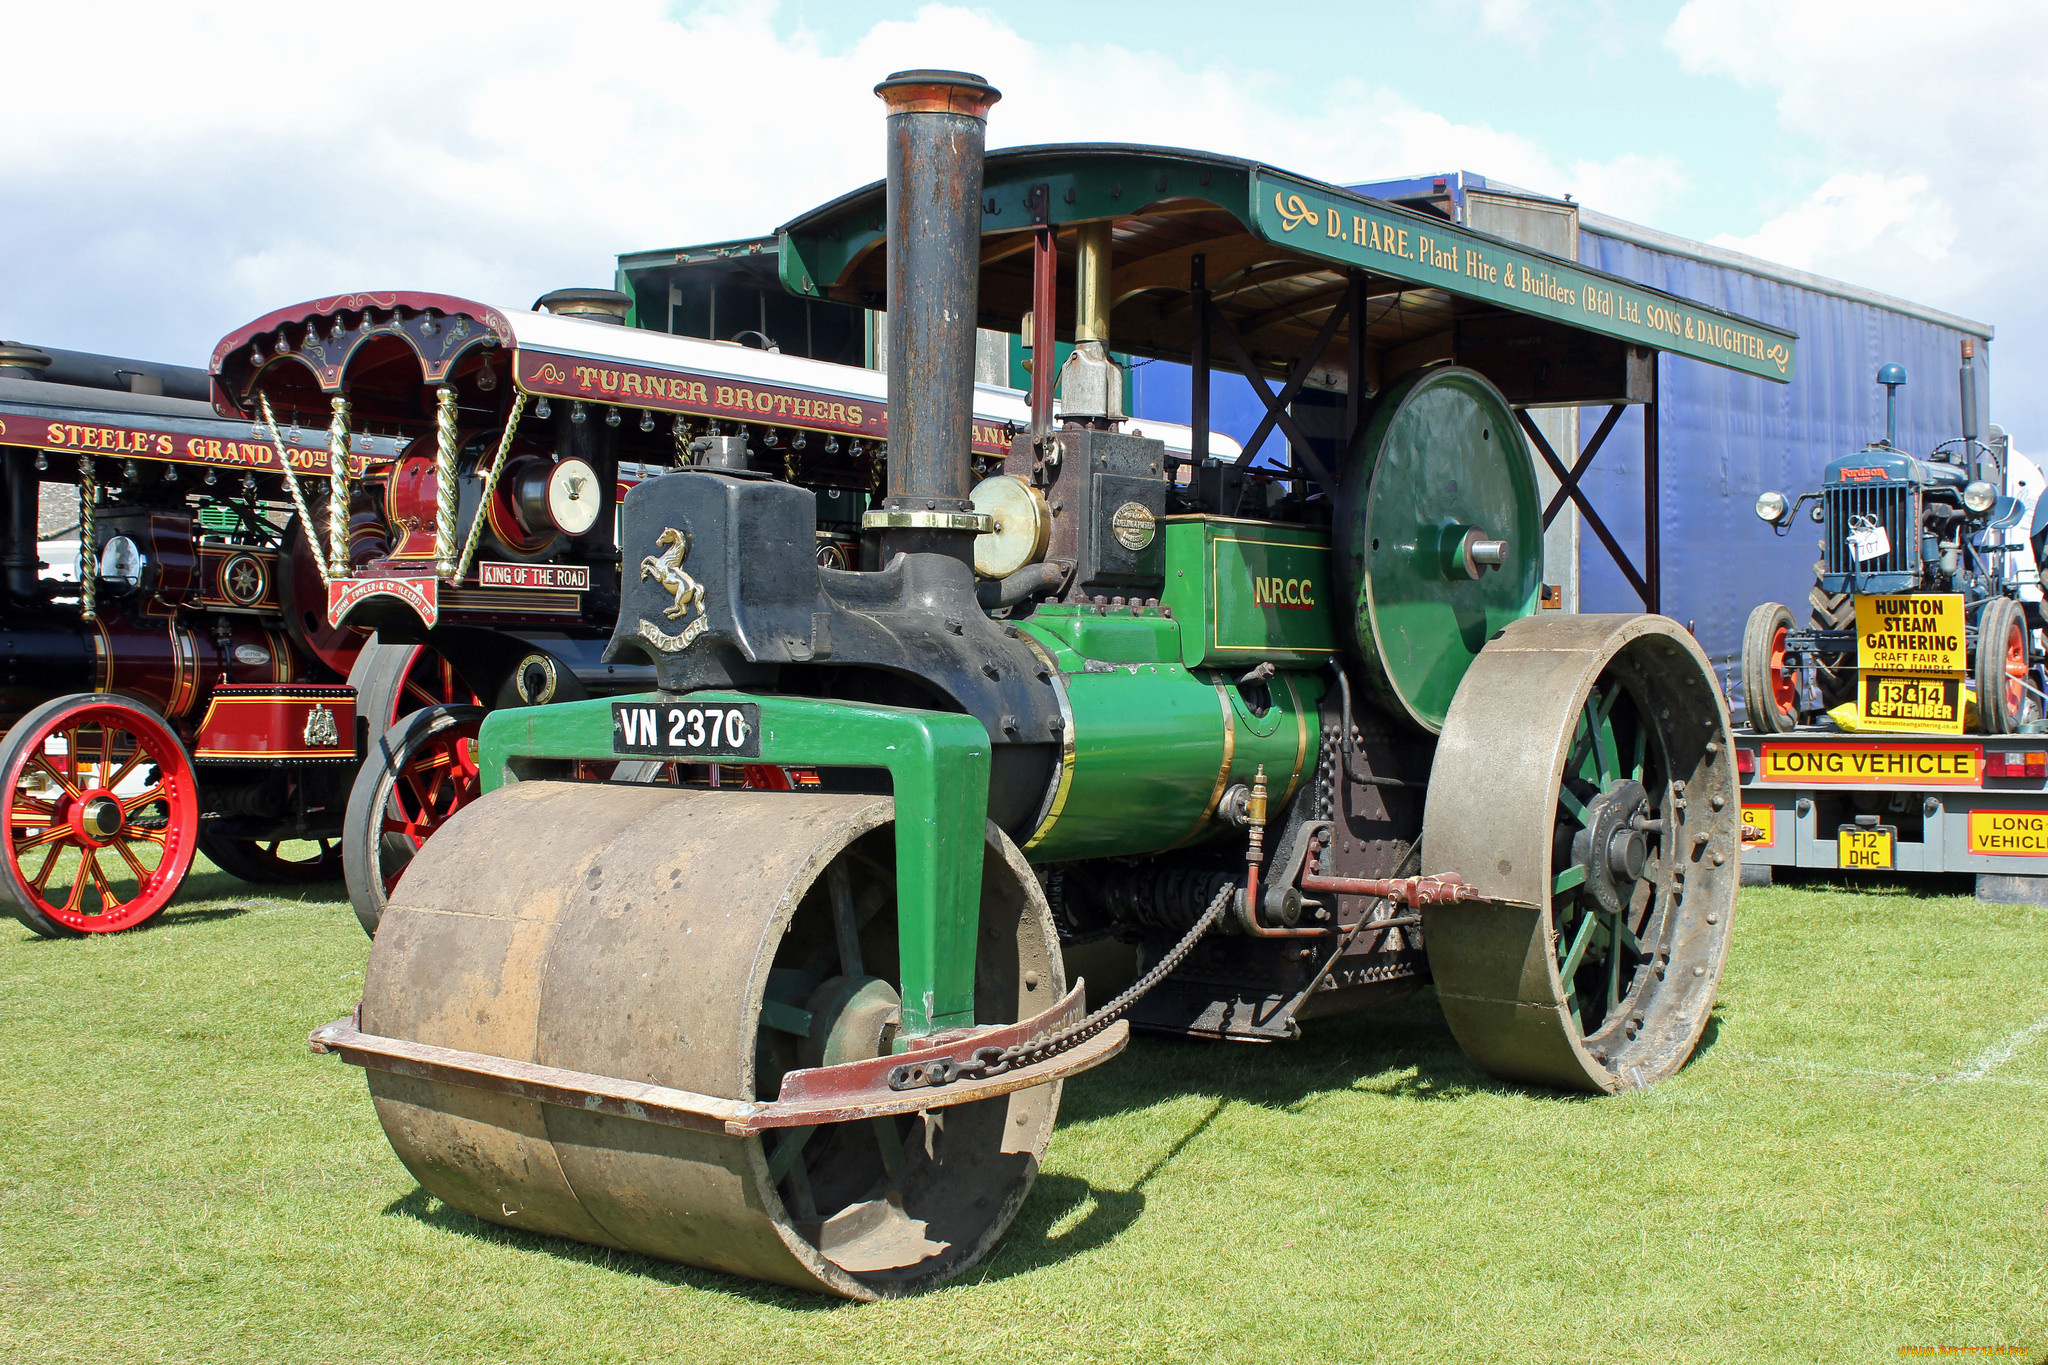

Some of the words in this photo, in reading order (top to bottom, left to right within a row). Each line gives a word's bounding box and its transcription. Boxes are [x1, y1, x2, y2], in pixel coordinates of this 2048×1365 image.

[1419, 235, 1459, 273] Plant
[1465, 250, 1498, 283] Hire
[1503, 262, 1516, 289] &
[1521, 266, 1576, 306] Builders
[1582, 283, 1614, 322] (Bfd)
[1618, 296, 1642, 325] Ltd.
[1646, 304, 1681, 335] SONS
[1684, 316, 1695, 340] &
[1697, 320, 1765, 361] DAUGHTER
[574, 365, 708, 403] TURNER
[715, 385, 864, 427] BROTHERS
[47, 422, 174, 456] STEELE'S
[187, 437, 273, 465] GRAND
[1840, 467, 1890, 482] Fordson
[484, 566, 512, 584] KING
[514, 568, 529, 584] OF
[532, 568, 554, 586] THE
[557, 569, 586, 587] ROAD
[335, 598, 350, 618] JOHN
[351, 583, 376, 600] FOWLER
[379, 582, 385, 590] &
[398, 585, 422, 607] (LEEDS)
[1875, 599, 1944, 616] HUNTON
[1884, 616, 1938, 633] STEAM
[1866, 633, 1958, 652] GATHERING
[1873, 651, 1909, 662] CRAFT
[1912, 653, 1938, 663] FAIR
[1942, 654, 1950, 664] &
[1872, 662, 1905, 673] AUTO
[1909, 664, 1954, 675] JUMBLE
[1882, 685, 1903, 703] 13
[1906, 687, 1917, 702] &
[1920, 687, 1941, 704] 14
[1870, 701, 1953, 719] SEPTEMBER
[620, 708, 658, 746] VN
[668, 708, 746, 748] 2370
[1772, 752, 1844, 772] LONG
[1851, 753, 1969, 774] VEHICLE
[1993, 817, 2043, 831] LONG
[1852, 833, 1877, 849] F12
[1979, 834, 2048, 849] VEHICL
[1850, 850, 1881, 866] DHC
